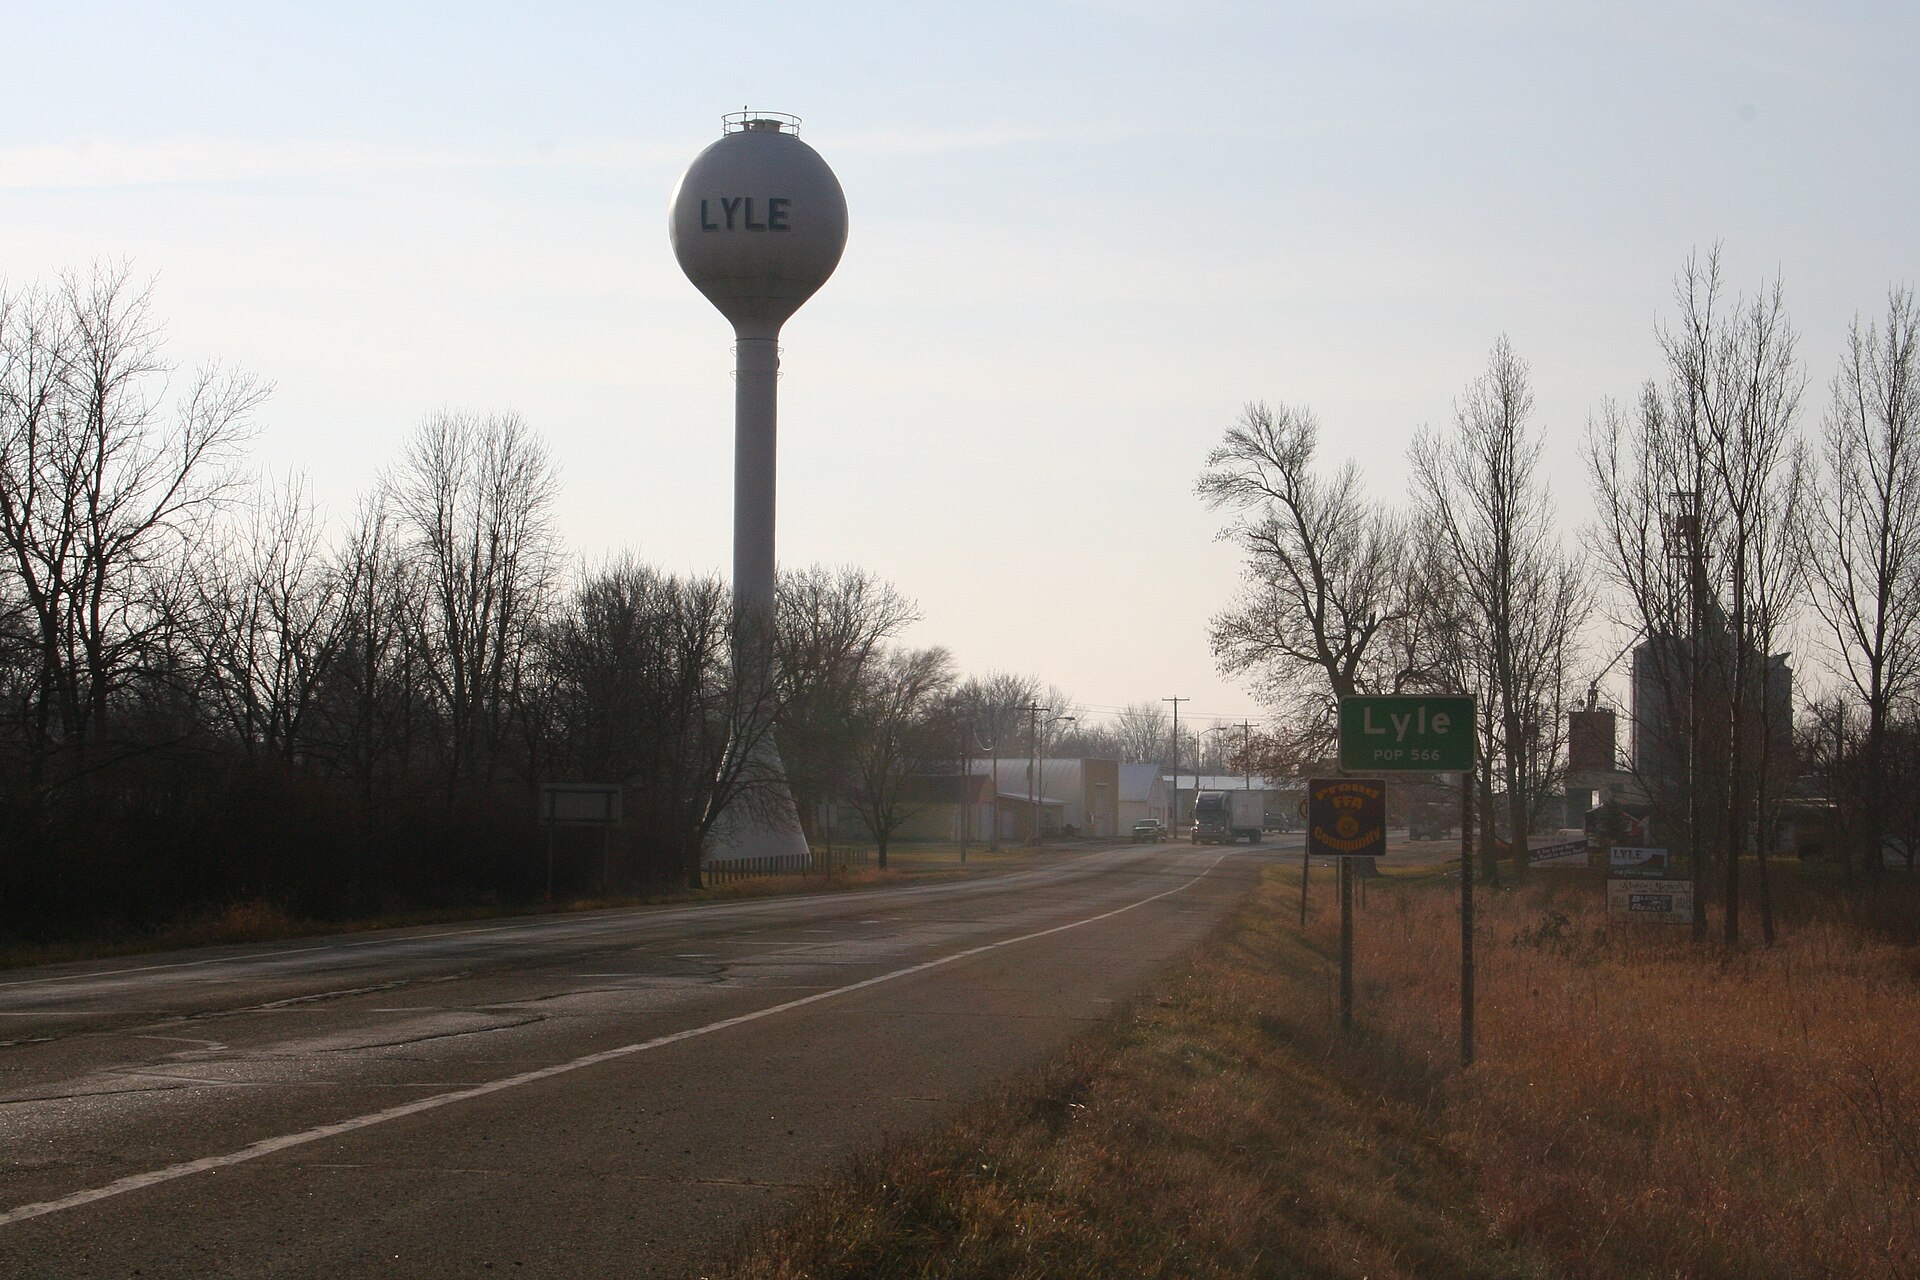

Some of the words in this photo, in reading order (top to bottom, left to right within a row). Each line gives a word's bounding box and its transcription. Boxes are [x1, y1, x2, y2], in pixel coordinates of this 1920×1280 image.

[701, 197, 792, 232] LYLE
[1363, 706, 1451, 742] Lyle
[1373, 749, 1404, 761] POP
[1411, 749, 1440, 761] 566
[1332, 795, 1364, 810] FFA
[1613, 849, 1643, 859] LYLE
